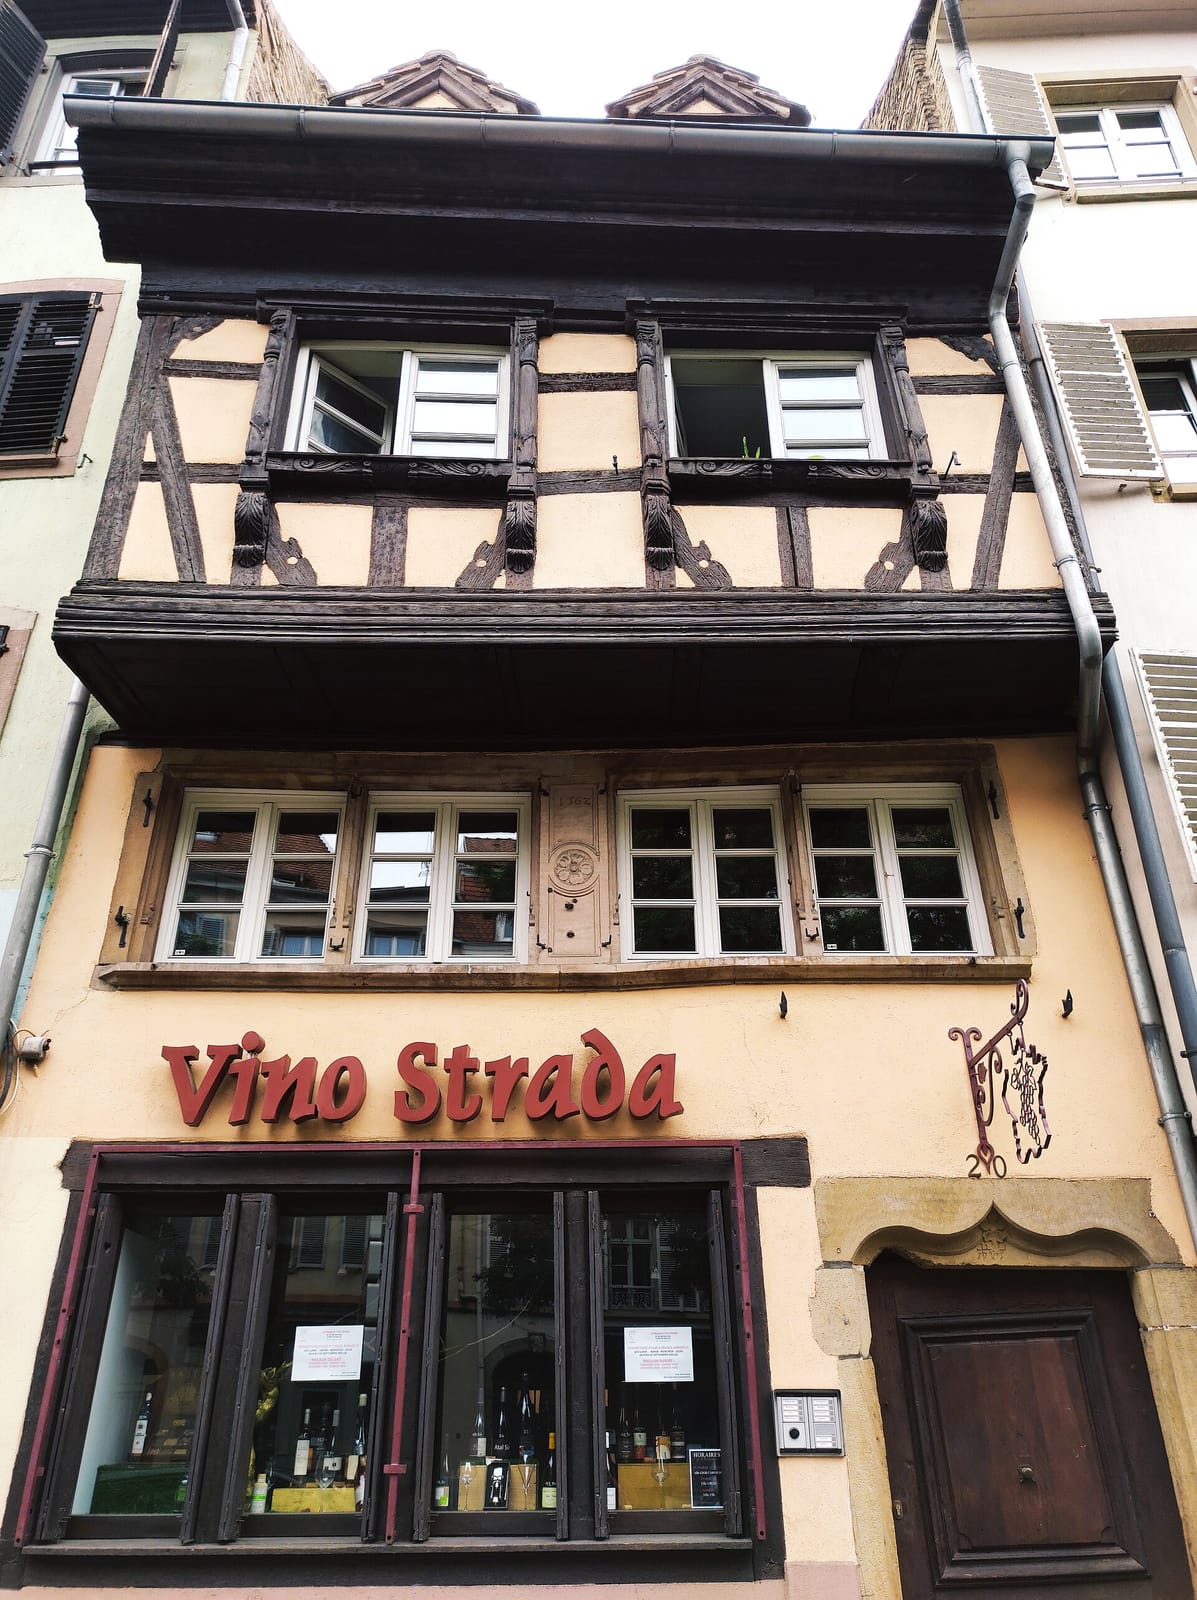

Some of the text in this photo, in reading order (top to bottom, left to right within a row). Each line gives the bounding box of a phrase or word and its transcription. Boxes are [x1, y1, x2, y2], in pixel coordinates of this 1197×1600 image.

[161, 1027, 684, 1127] Vino Strada
[966, 1155, 1007, 1179] 20
